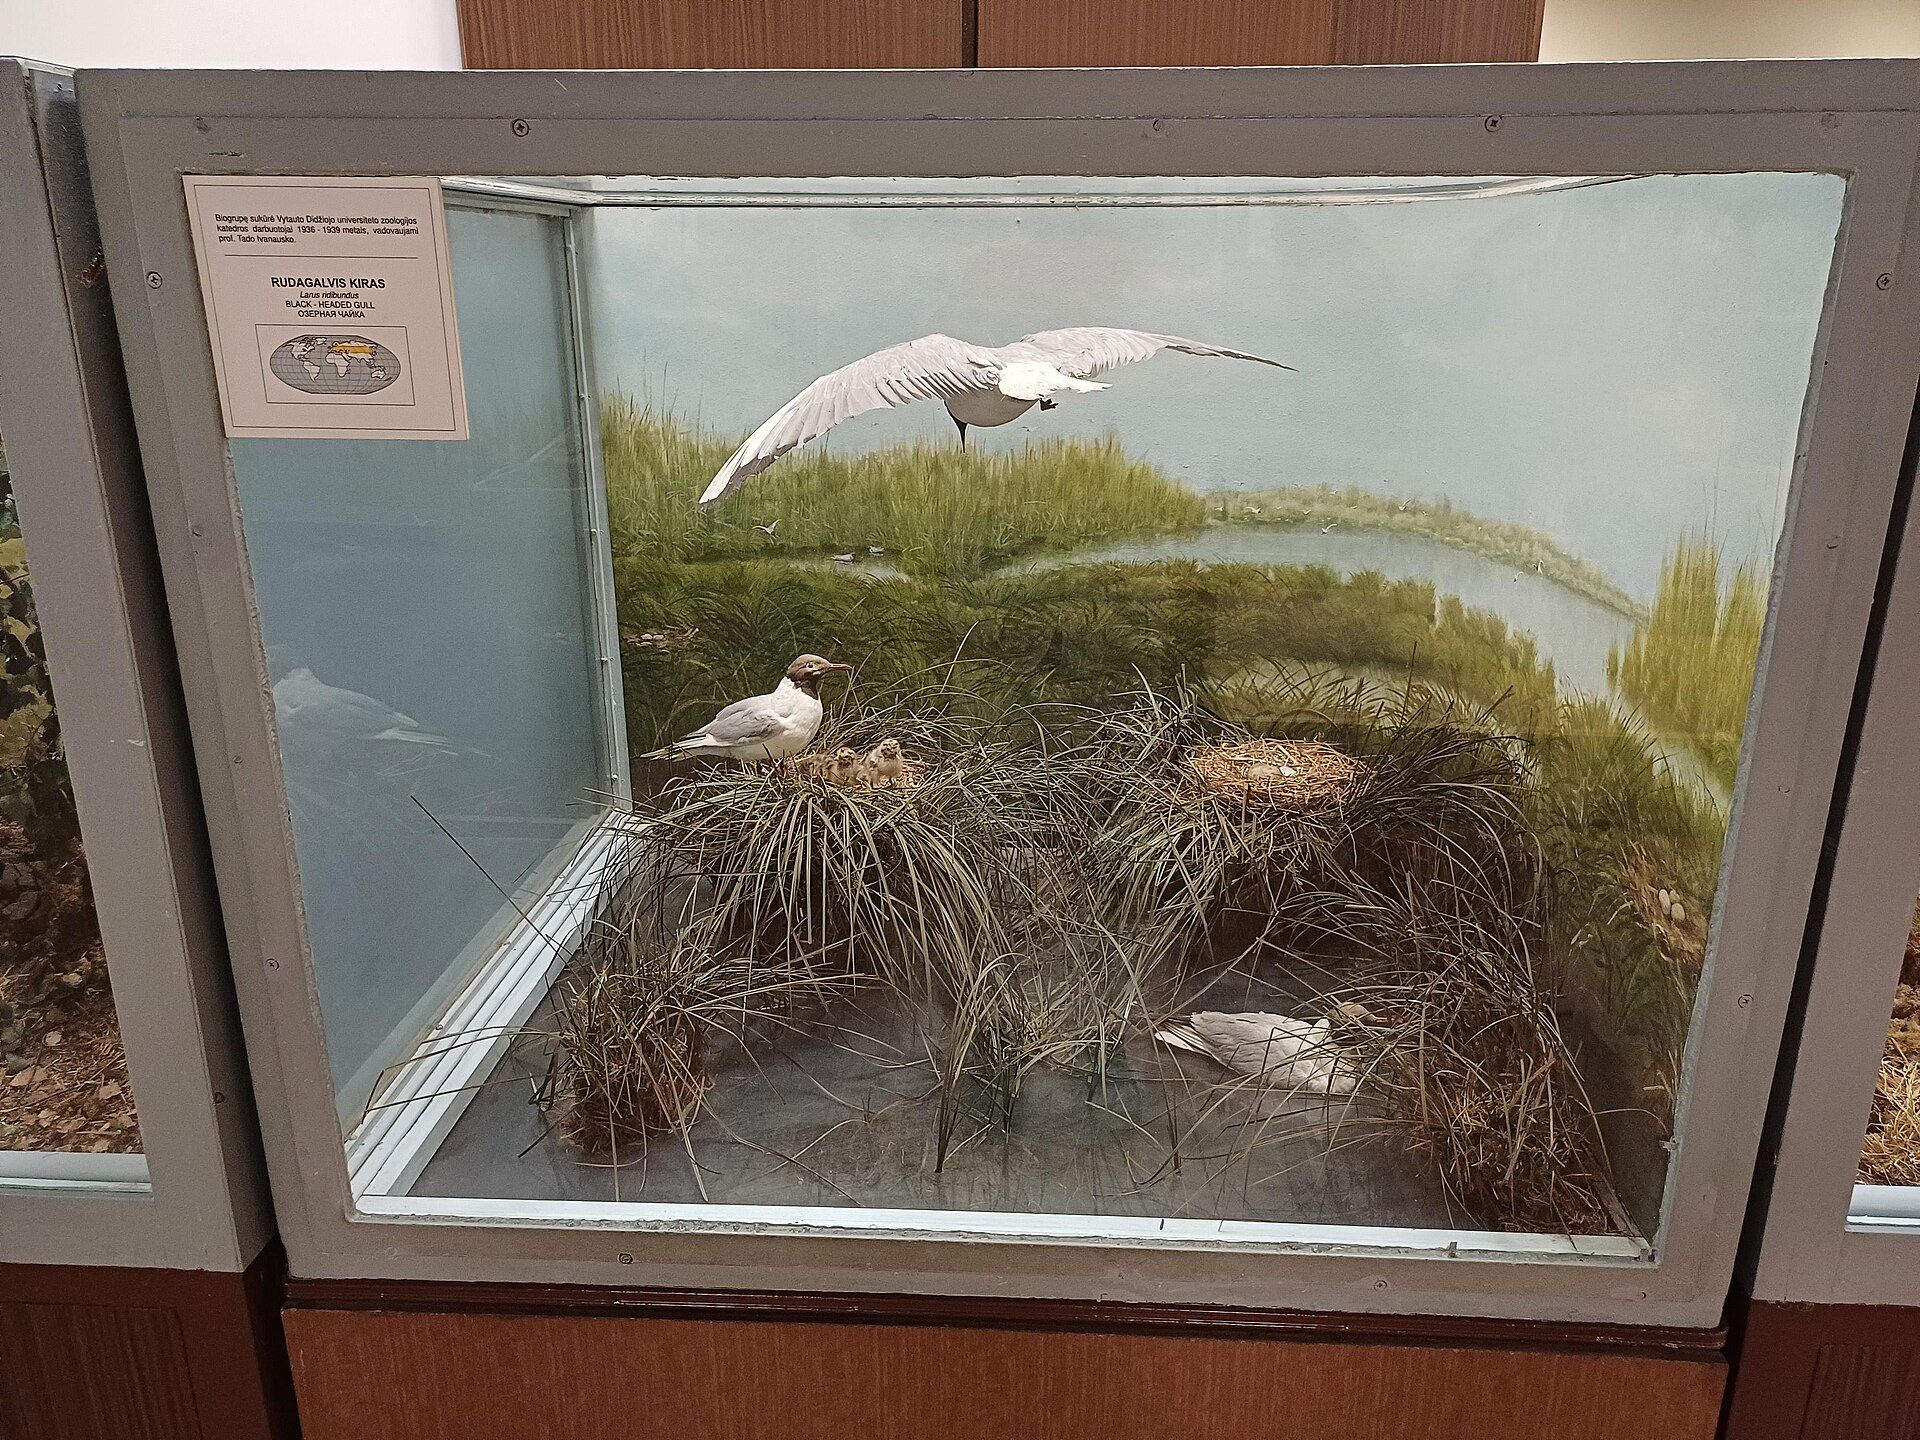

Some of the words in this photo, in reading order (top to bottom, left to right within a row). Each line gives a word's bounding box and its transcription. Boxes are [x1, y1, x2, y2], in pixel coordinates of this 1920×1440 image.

[215, 214, 248, 224] Biogrupę
[276, 215, 304, 225] Vytauto
[306, 215, 335, 225] Didžiojo
[337, 216, 379, 224] universiteto
[381, 216, 417, 226] zoologijos
[217, 225, 249, 233] katedros
[253, 225, 293, 234] darbuotojai
[323, 226, 340, 234] 1939
[343, 226, 369, 235] metais,
[373, 227, 419, 236] vadovaujami
[219, 235, 235, 243] prof.
[257, 235, 296, 243] Ivanausko.
[271, 277, 346, 288] RUDAGALVIS
[350, 278, 385, 288] KIRAS
[300, 291, 320, 299] Larus
[322, 291, 359, 299] ridibundus
[285, 300, 312, 308] BLACK
[319, 301, 352, 309] HEADED
[354, 301, 375, 309] GULL
[298, 310, 336, 318] ОЗЕРНАЯ
[338, 309, 365, 318] ЧАЙКА
